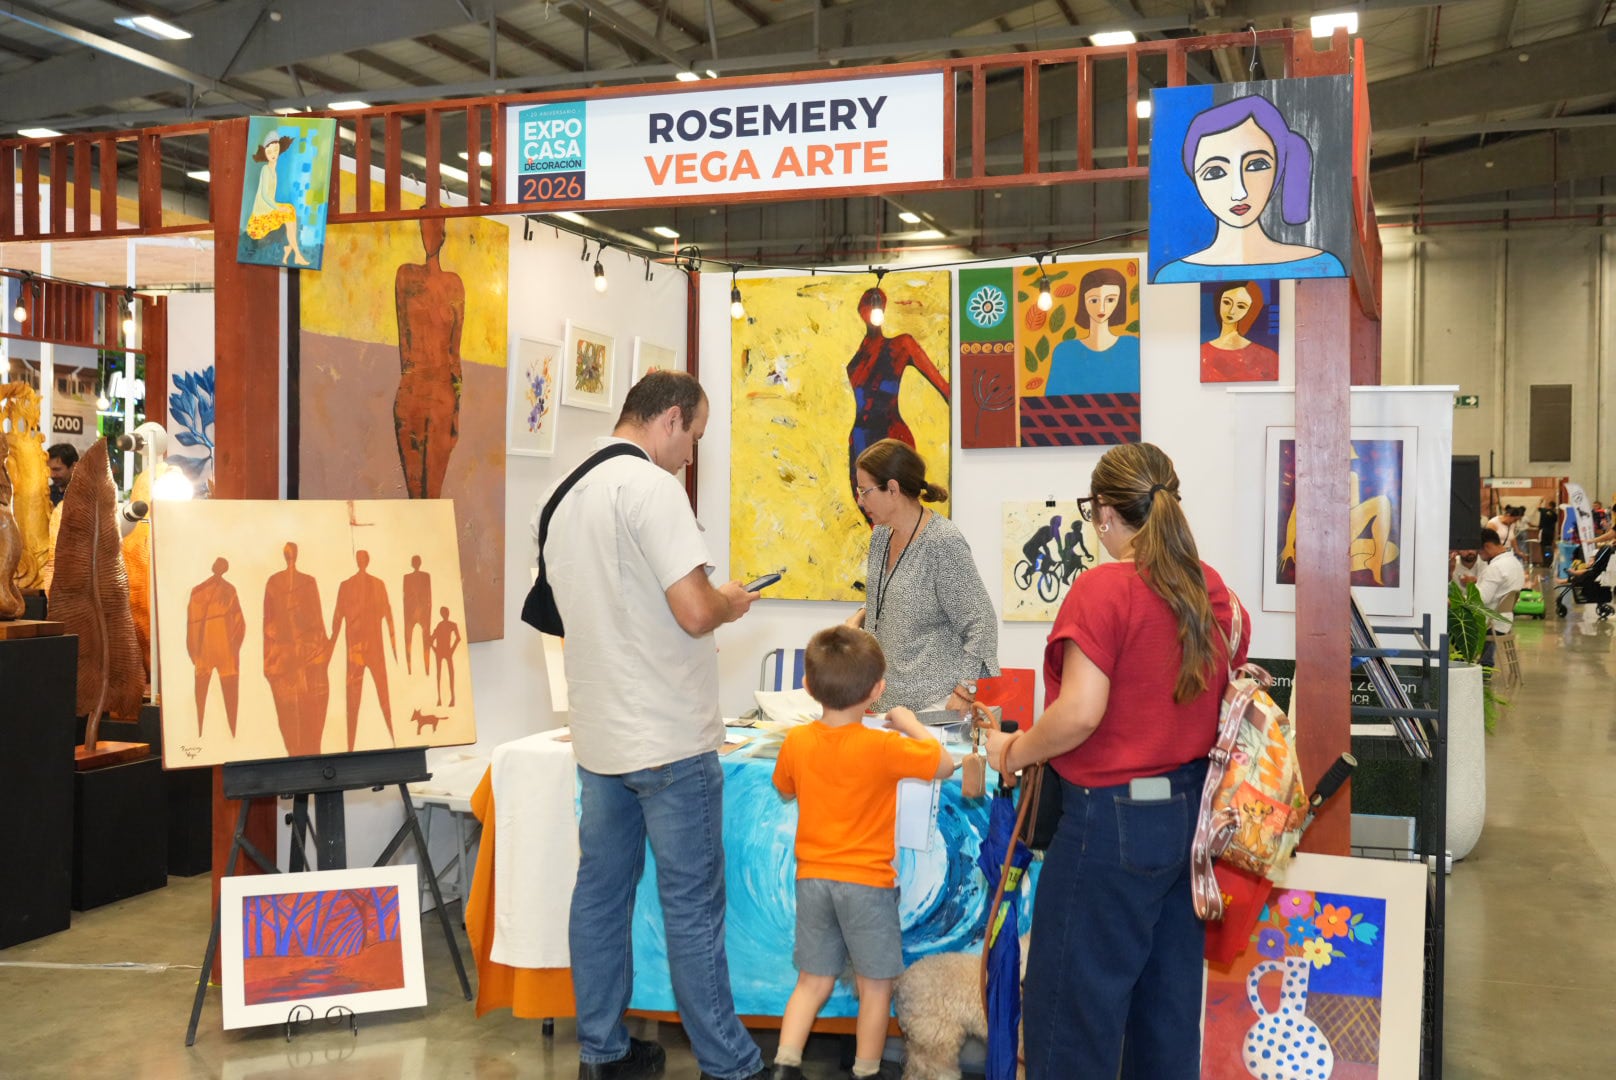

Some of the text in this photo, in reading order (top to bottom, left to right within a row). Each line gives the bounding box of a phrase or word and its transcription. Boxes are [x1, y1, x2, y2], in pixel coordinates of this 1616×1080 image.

[539, 108, 577, 117] ANIVERSARIO
[649, 95, 888, 144] ROSEMERY
[524, 117, 583, 141] EXPO
[523, 139, 582, 160] CASA
[524, 159, 582, 171] DECORACIÓN
[643, 139, 889, 186] VEGA ARTE
[523, 176, 582, 200] 2026
